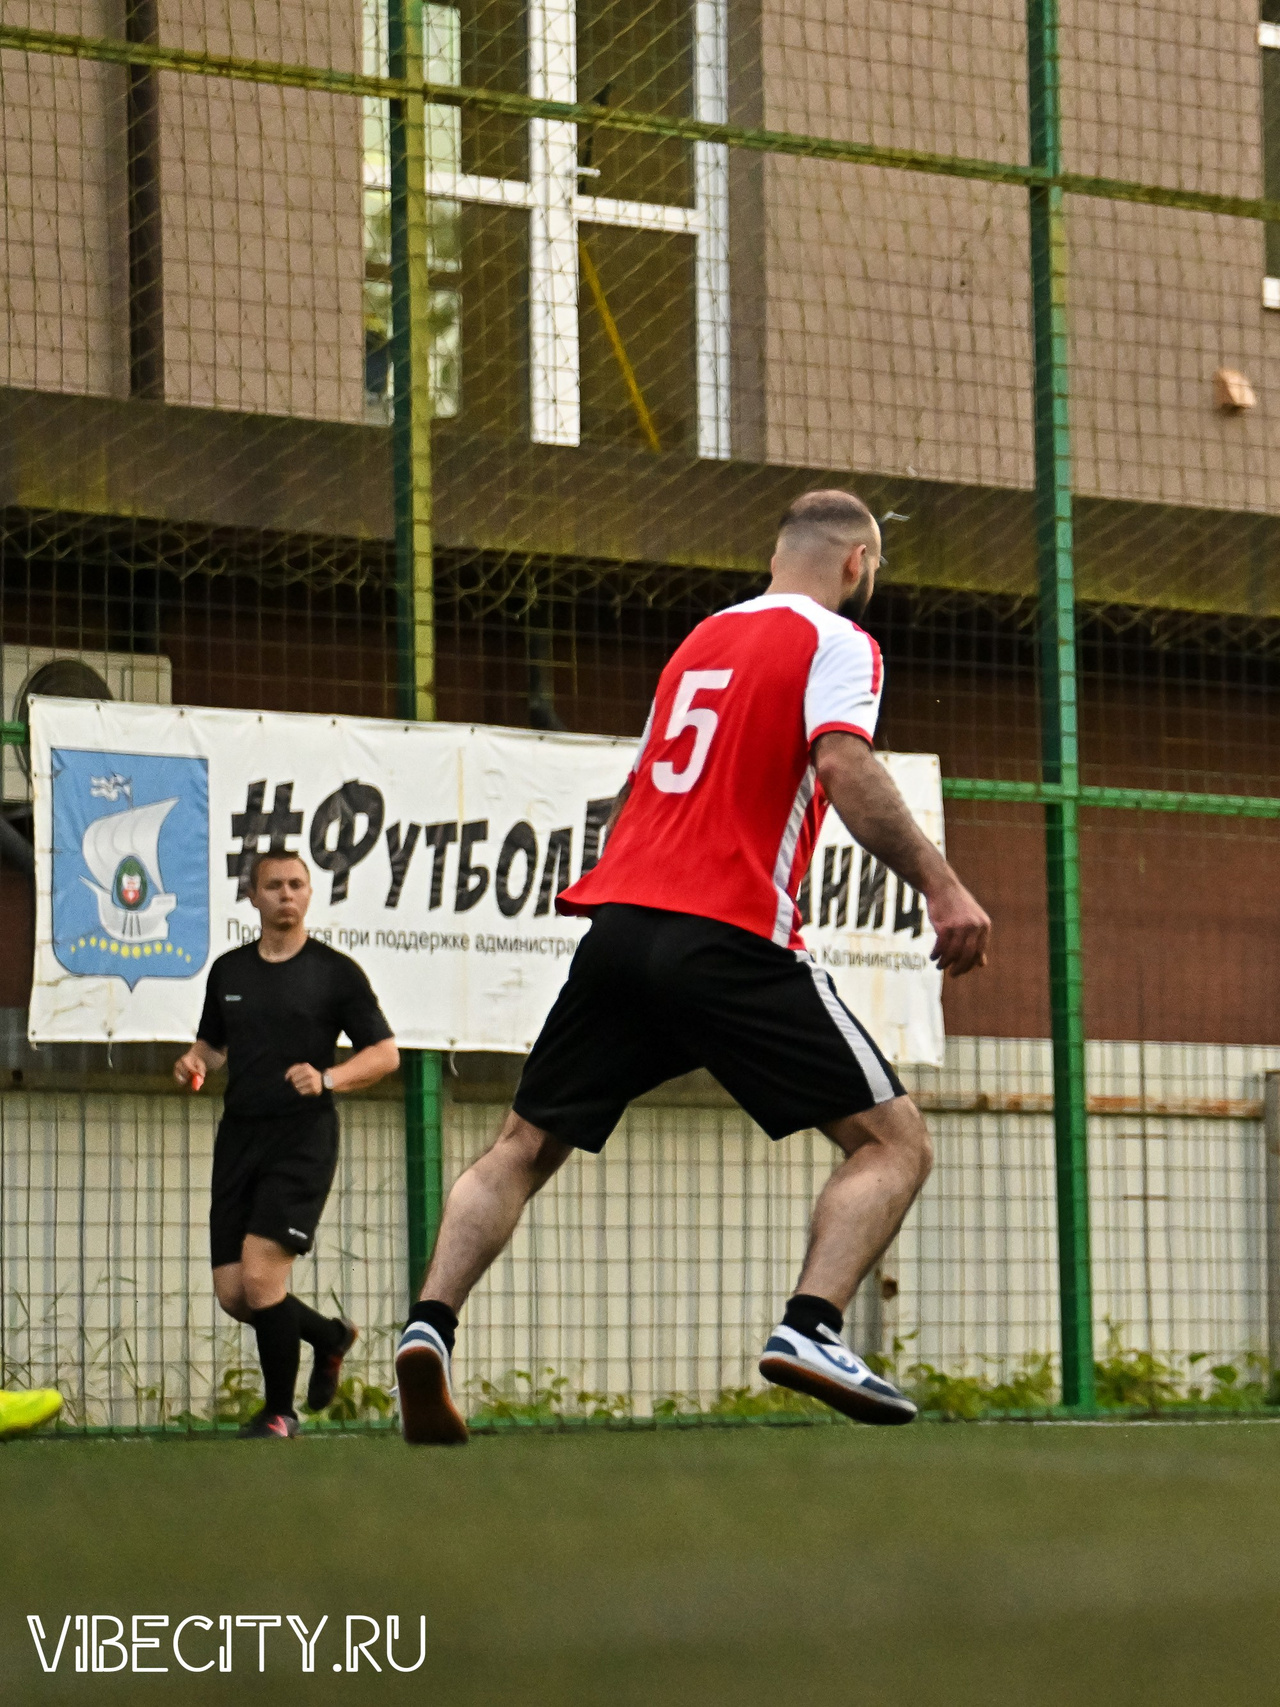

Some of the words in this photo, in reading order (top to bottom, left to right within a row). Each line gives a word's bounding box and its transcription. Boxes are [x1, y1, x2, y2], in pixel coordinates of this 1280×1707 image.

[652, 668, 734, 794] 5
[227, 918, 332, 946] Протся
[338, 928, 369, 950] при
[376, 929, 470, 955] поддержке
[475, 933, 580, 958] администра
